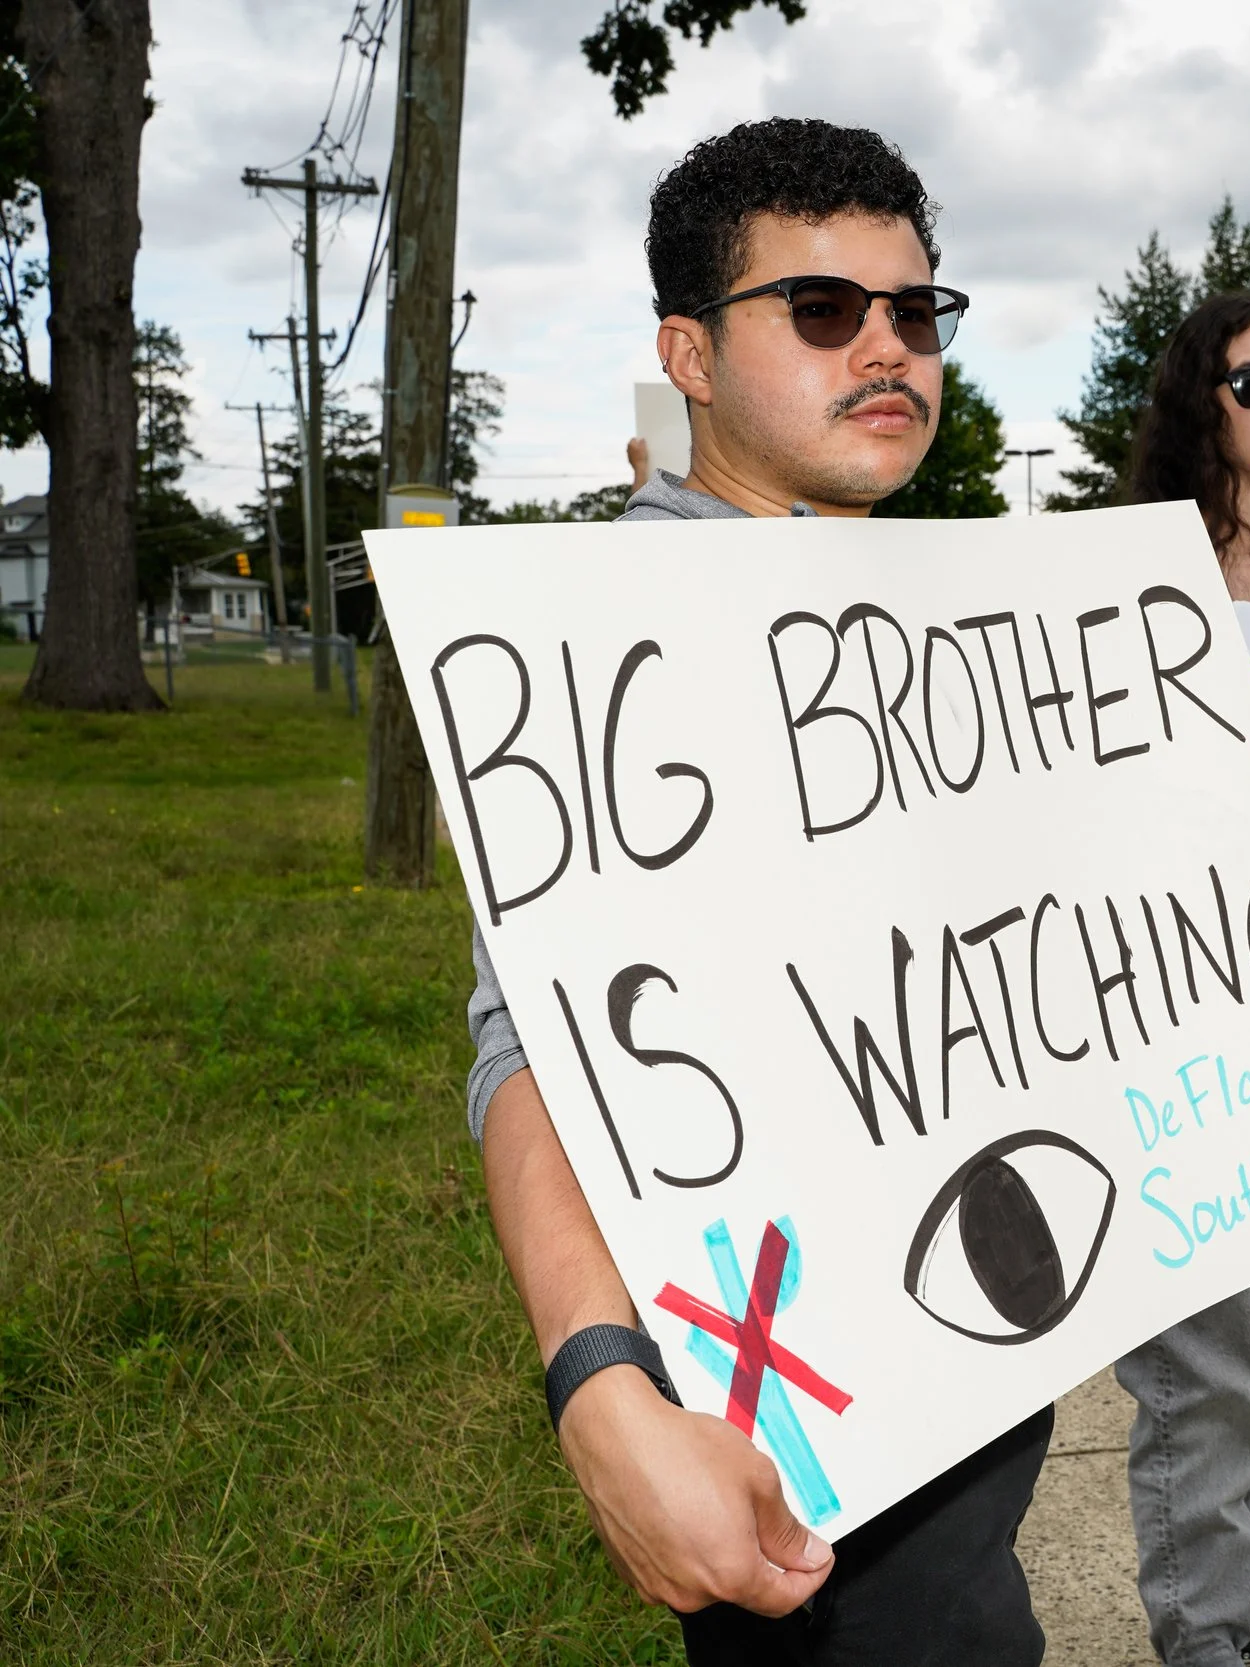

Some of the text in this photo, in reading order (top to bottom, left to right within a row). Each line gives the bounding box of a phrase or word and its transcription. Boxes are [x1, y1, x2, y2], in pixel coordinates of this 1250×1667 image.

[431, 585, 1246, 926] BIG BROTHER
[552, 963, 744, 1200] IS
